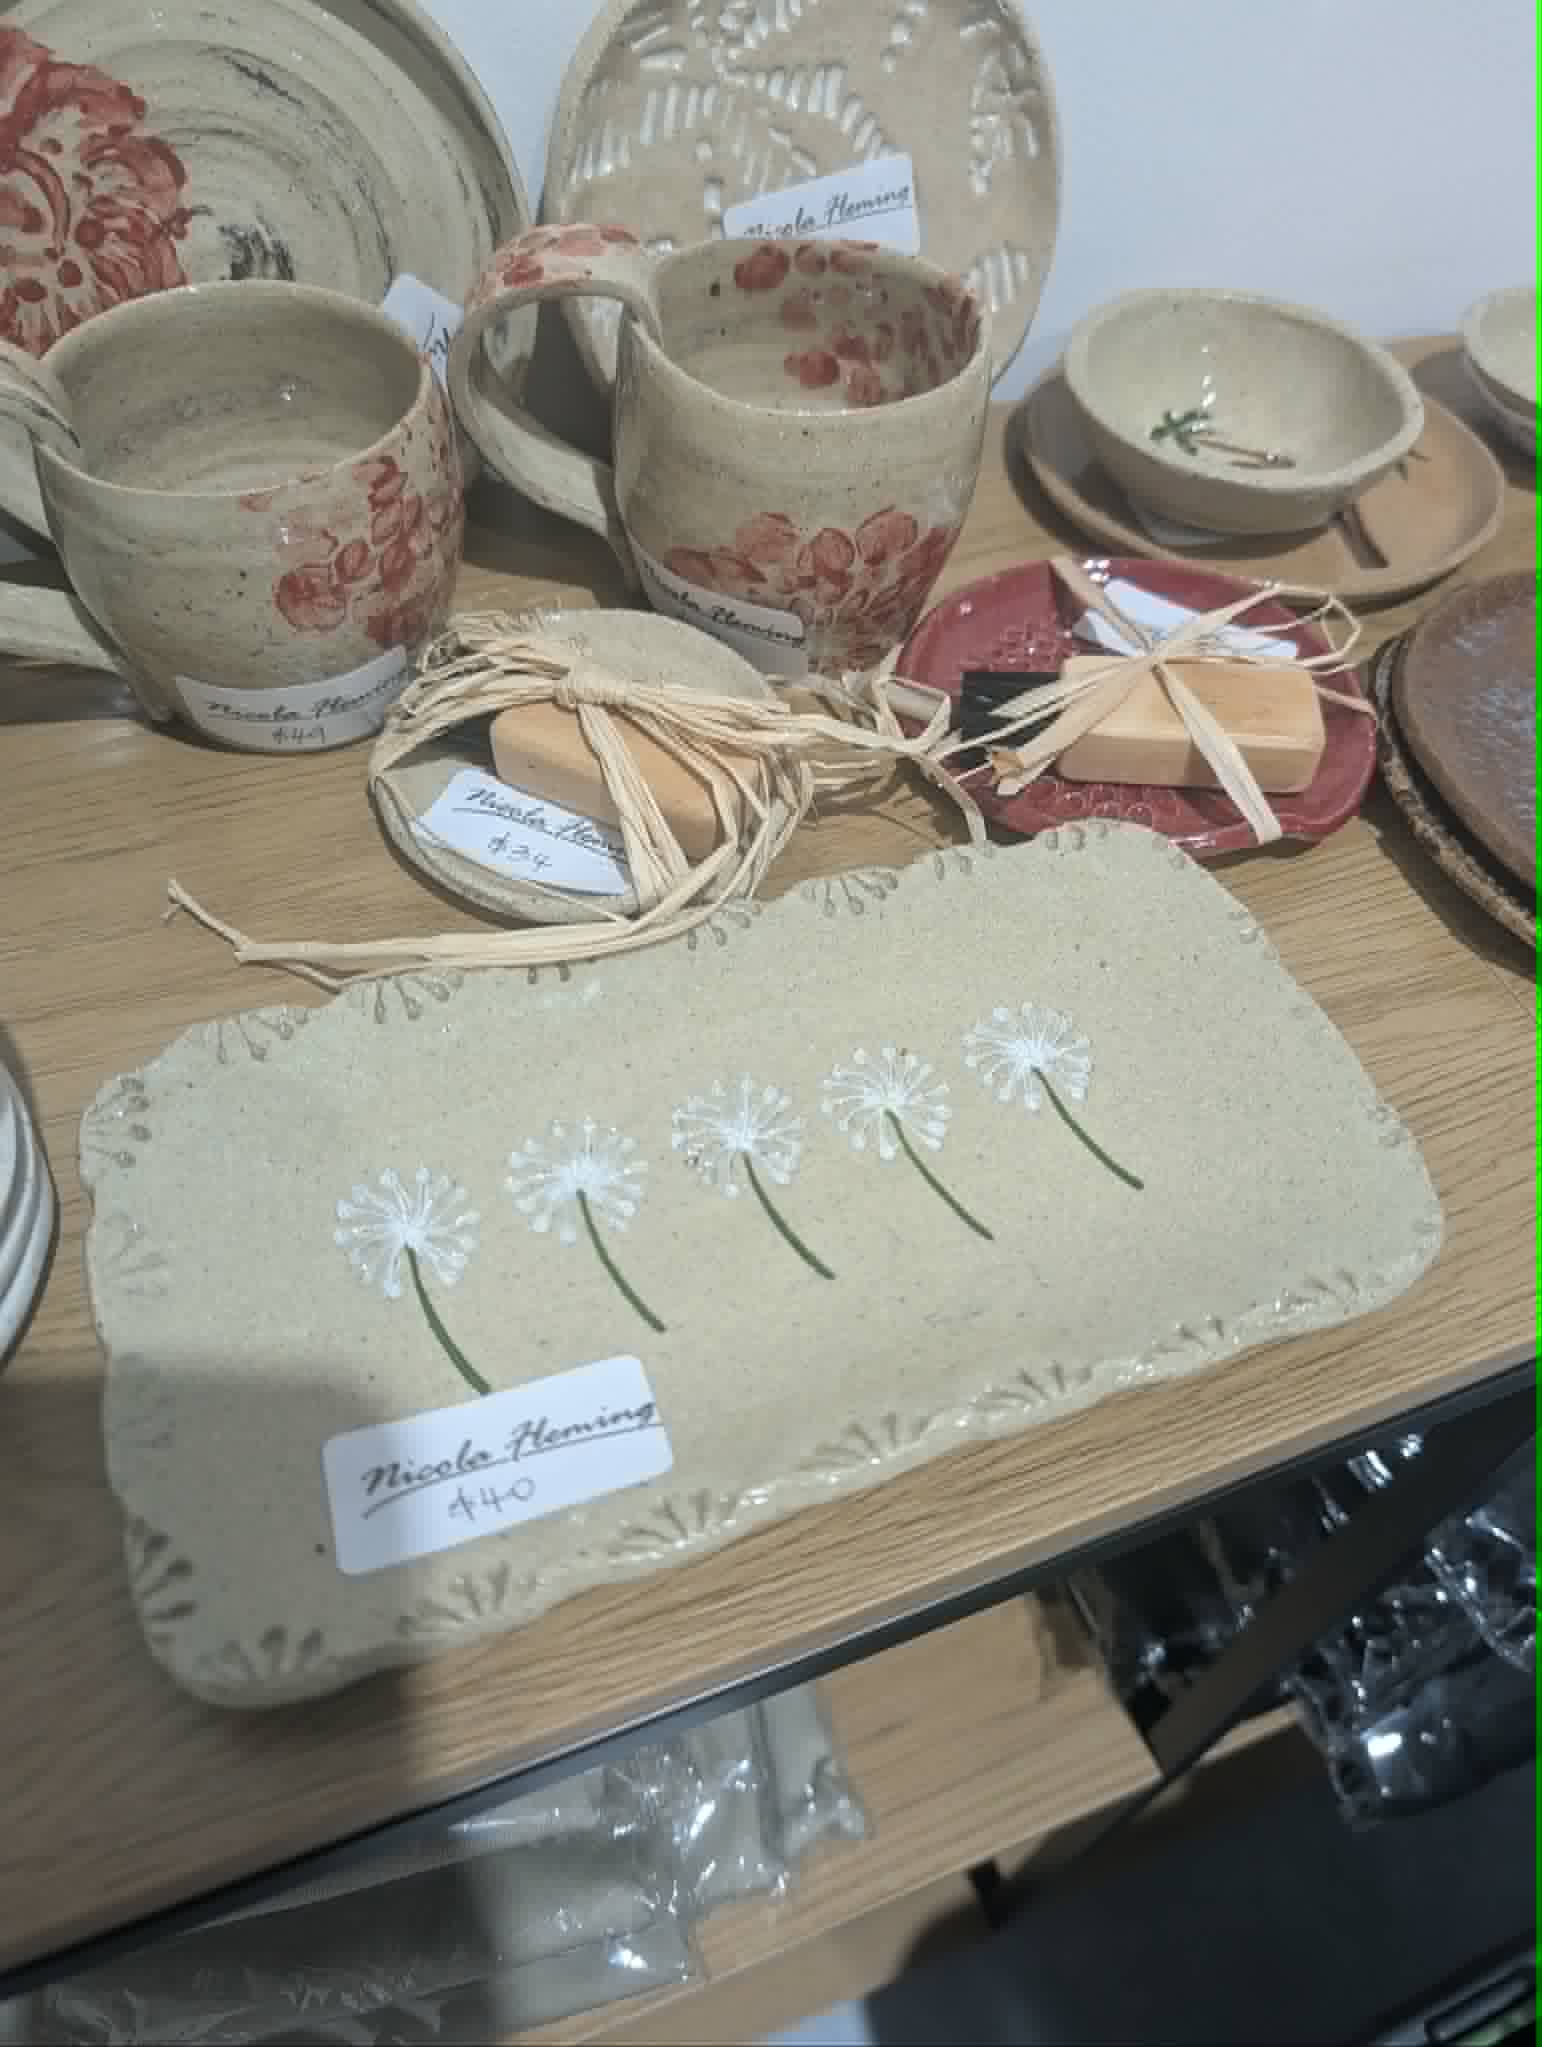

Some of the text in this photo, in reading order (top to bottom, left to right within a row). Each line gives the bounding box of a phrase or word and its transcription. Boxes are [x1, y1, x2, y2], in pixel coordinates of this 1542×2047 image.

[823, 184, 911, 226] Fleming
[710, 604, 806, 645] Fleming
[464, 787, 546, 832] Nicola
[487, 831, 553, 873] $34
[361, 1400, 656, 1496] Nicola Fleming
[448, 1476, 537, 1521] $40
